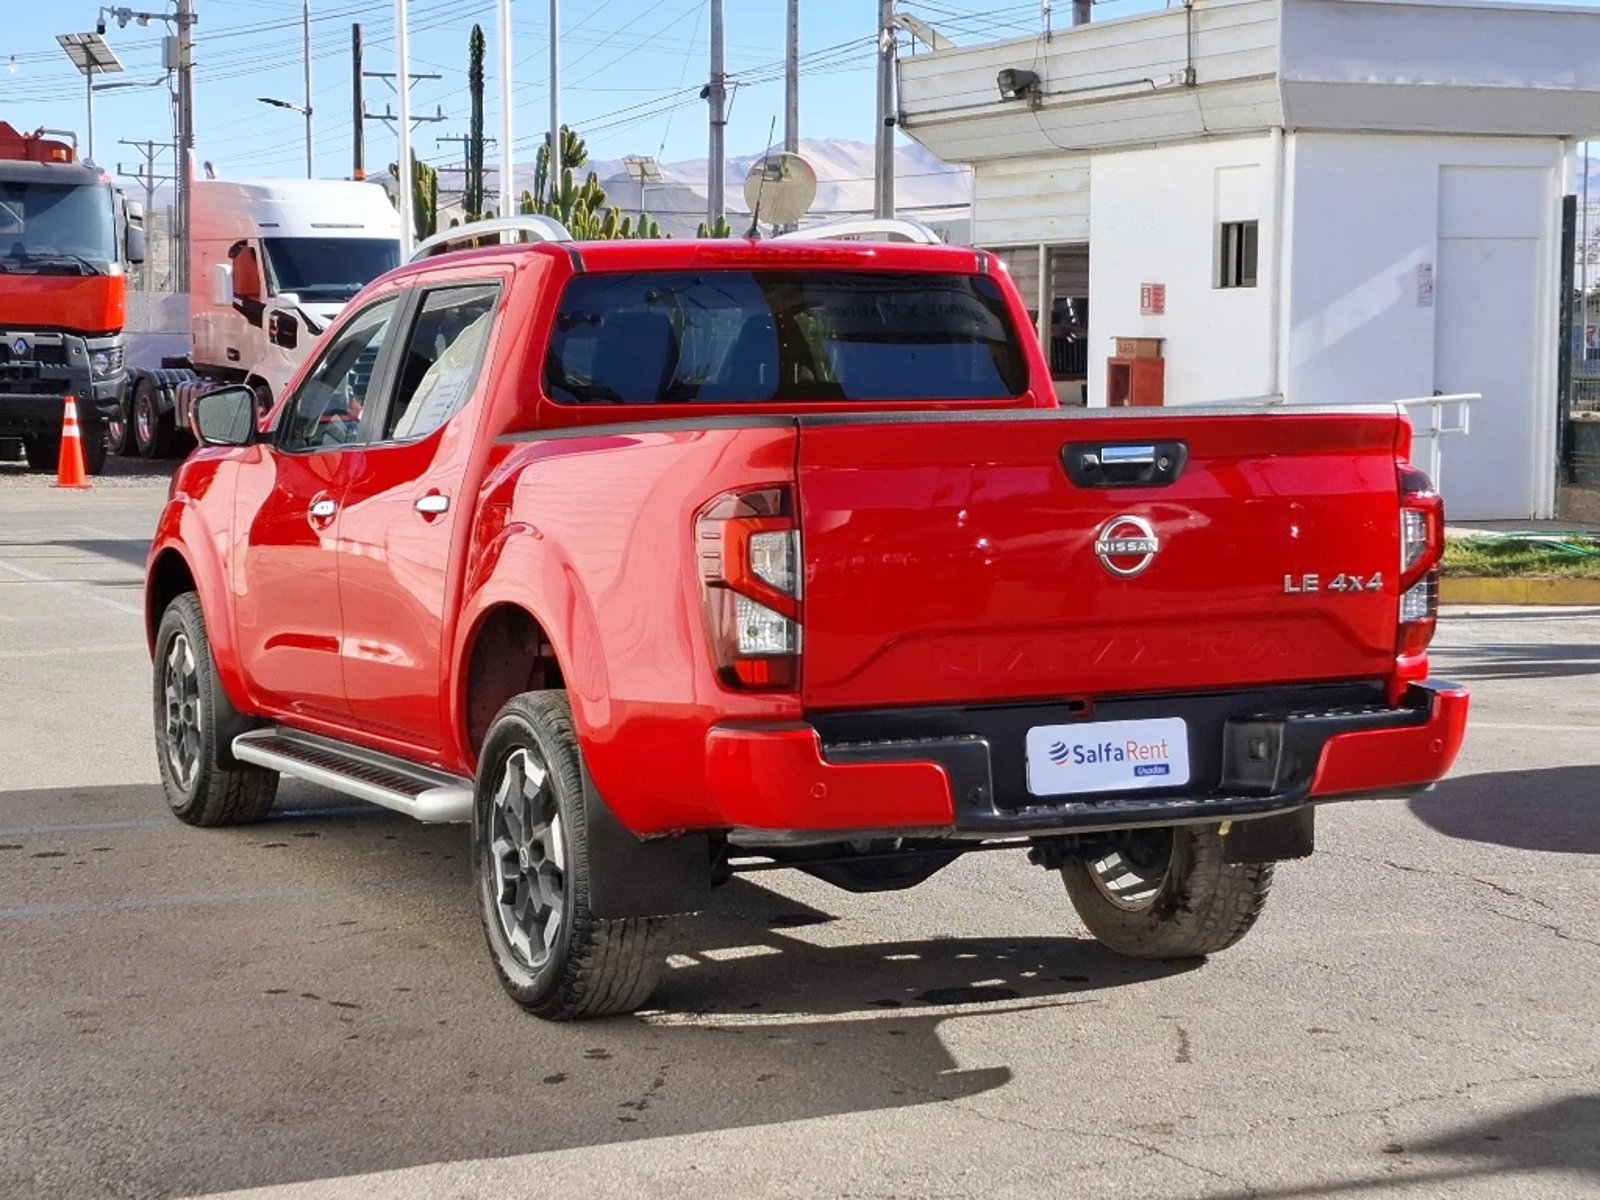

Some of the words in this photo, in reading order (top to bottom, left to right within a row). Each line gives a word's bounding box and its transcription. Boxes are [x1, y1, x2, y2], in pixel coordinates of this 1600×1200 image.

[1097, 541, 1158, 552] NISSAN
[1283, 574, 1319, 593] LE
[1328, 572, 1384, 593] 4x4
[1073, 739, 1169, 764] SalfaRent
